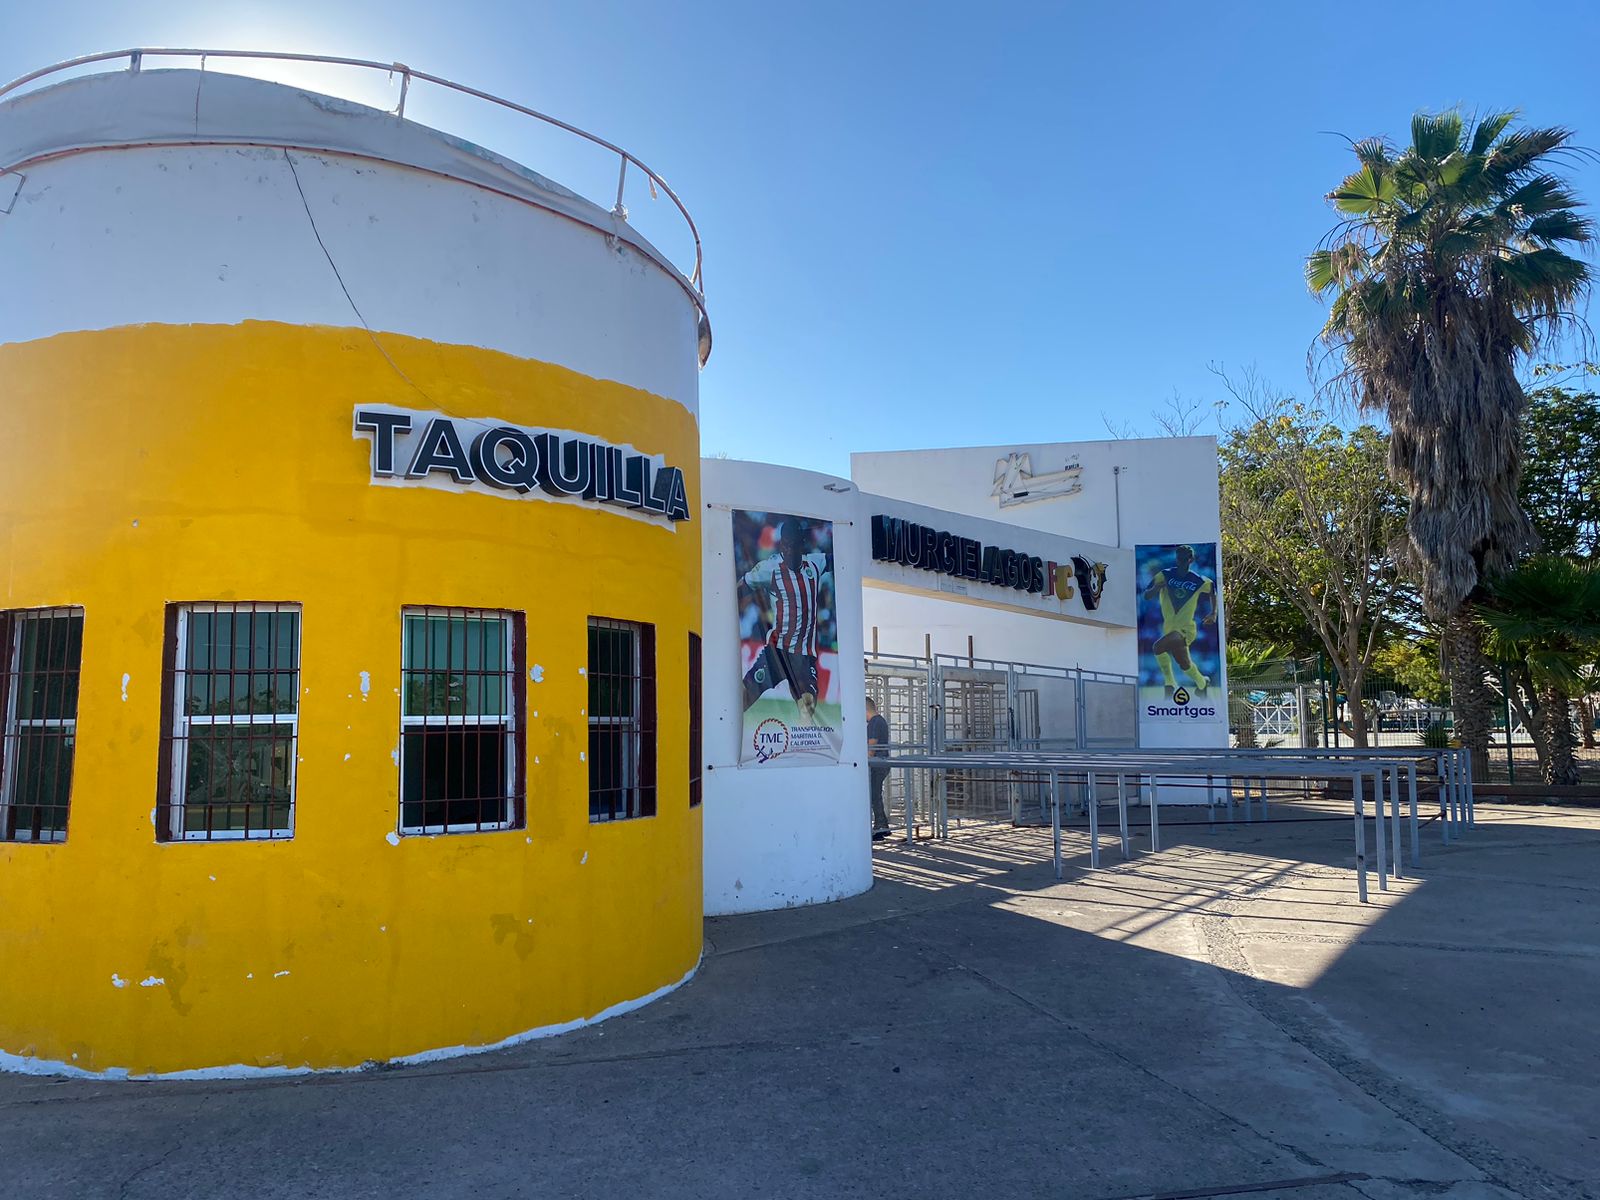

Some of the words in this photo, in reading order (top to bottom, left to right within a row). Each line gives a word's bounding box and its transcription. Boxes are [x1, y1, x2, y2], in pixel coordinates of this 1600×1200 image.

[354, 410, 691, 522] TAQUILLA
[871, 514, 1044, 594] MURCIELAGOS
[1042, 560, 1075, 601] FC
[1147, 705, 1215, 718] Smartgas
[760, 733, 783, 743] TMC
